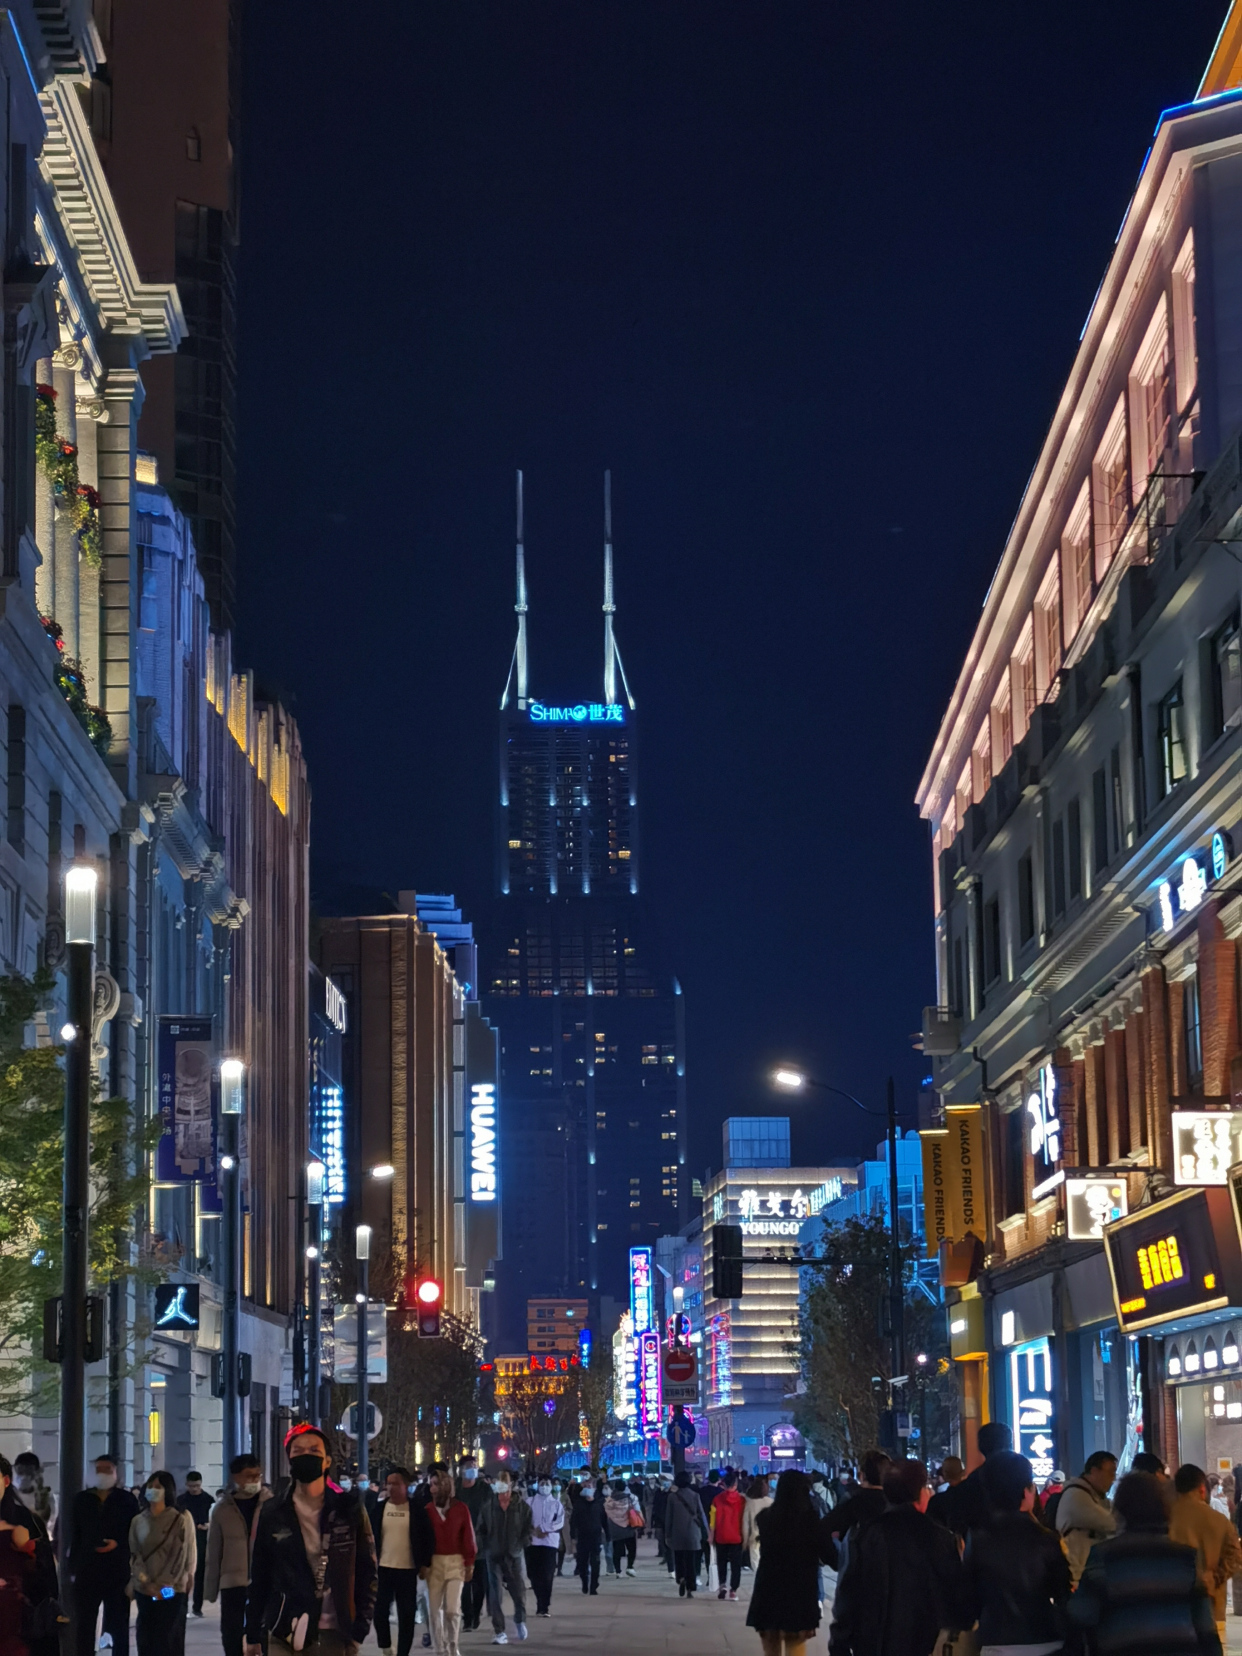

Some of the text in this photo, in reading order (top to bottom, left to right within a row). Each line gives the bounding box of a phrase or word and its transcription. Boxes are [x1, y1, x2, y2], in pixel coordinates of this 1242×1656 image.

[588, 704, 623, 721] 世茂
[471, 1083, 496, 1201] HUAWEI
[958, 1119, 974, 1226] KAKAO FRIENDS
[738, 1188, 808, 1218] 雅戈尔
[931, 1143, 946, 1243] KAKAO FRIENDS
